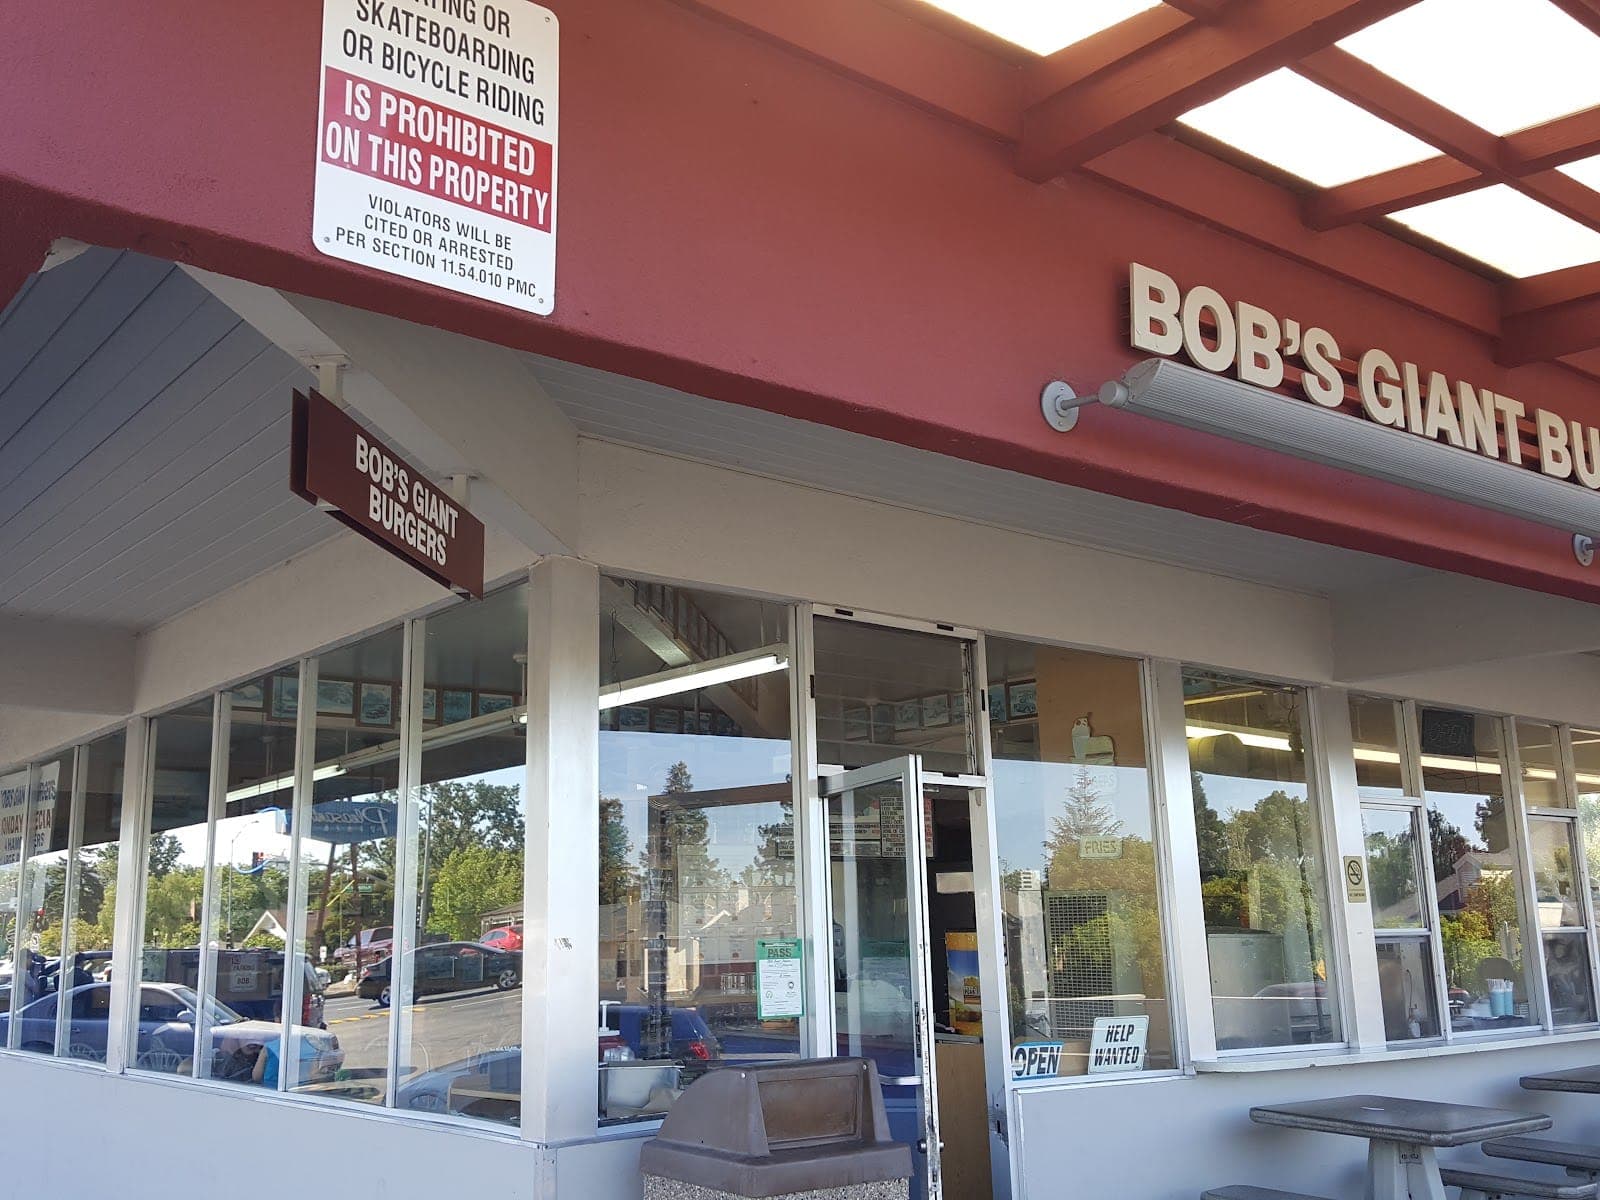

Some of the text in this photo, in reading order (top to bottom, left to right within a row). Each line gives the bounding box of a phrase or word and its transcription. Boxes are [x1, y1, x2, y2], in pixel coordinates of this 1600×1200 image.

[356, 0, 535, 85] SKATEBOARDING
[483, 4, 511, 38] OR
[343, 28, 545, 126] OR BICYCLE RIDING
[345, 79, 535, 177] IS PROHIBITED
[326, 121, 549, 226] ON THIS PROPERTY
[364, 214, 514, 271] CITED OR ARRESTED
[368, 193, 512, 251] VIOLATORS WILL BE
[336, 226, 537, 298] PER SECTION 11.54.010 PMC
[1130, 261, 1600, 490] BOB'S GIANT BU
[355, 433, 459, 539] BOB'S GIANT
[368, 484, 447, 566] BURGERS
[1084, 840, 1117, 854] FRIES
[767, 948, 792, 959] PASS
[1014, 1045, 1062, 1077] OPEN
[1094, 1045, 1140, 1067] WANTED
[1105, 1024, 1134, 1044] HELP
